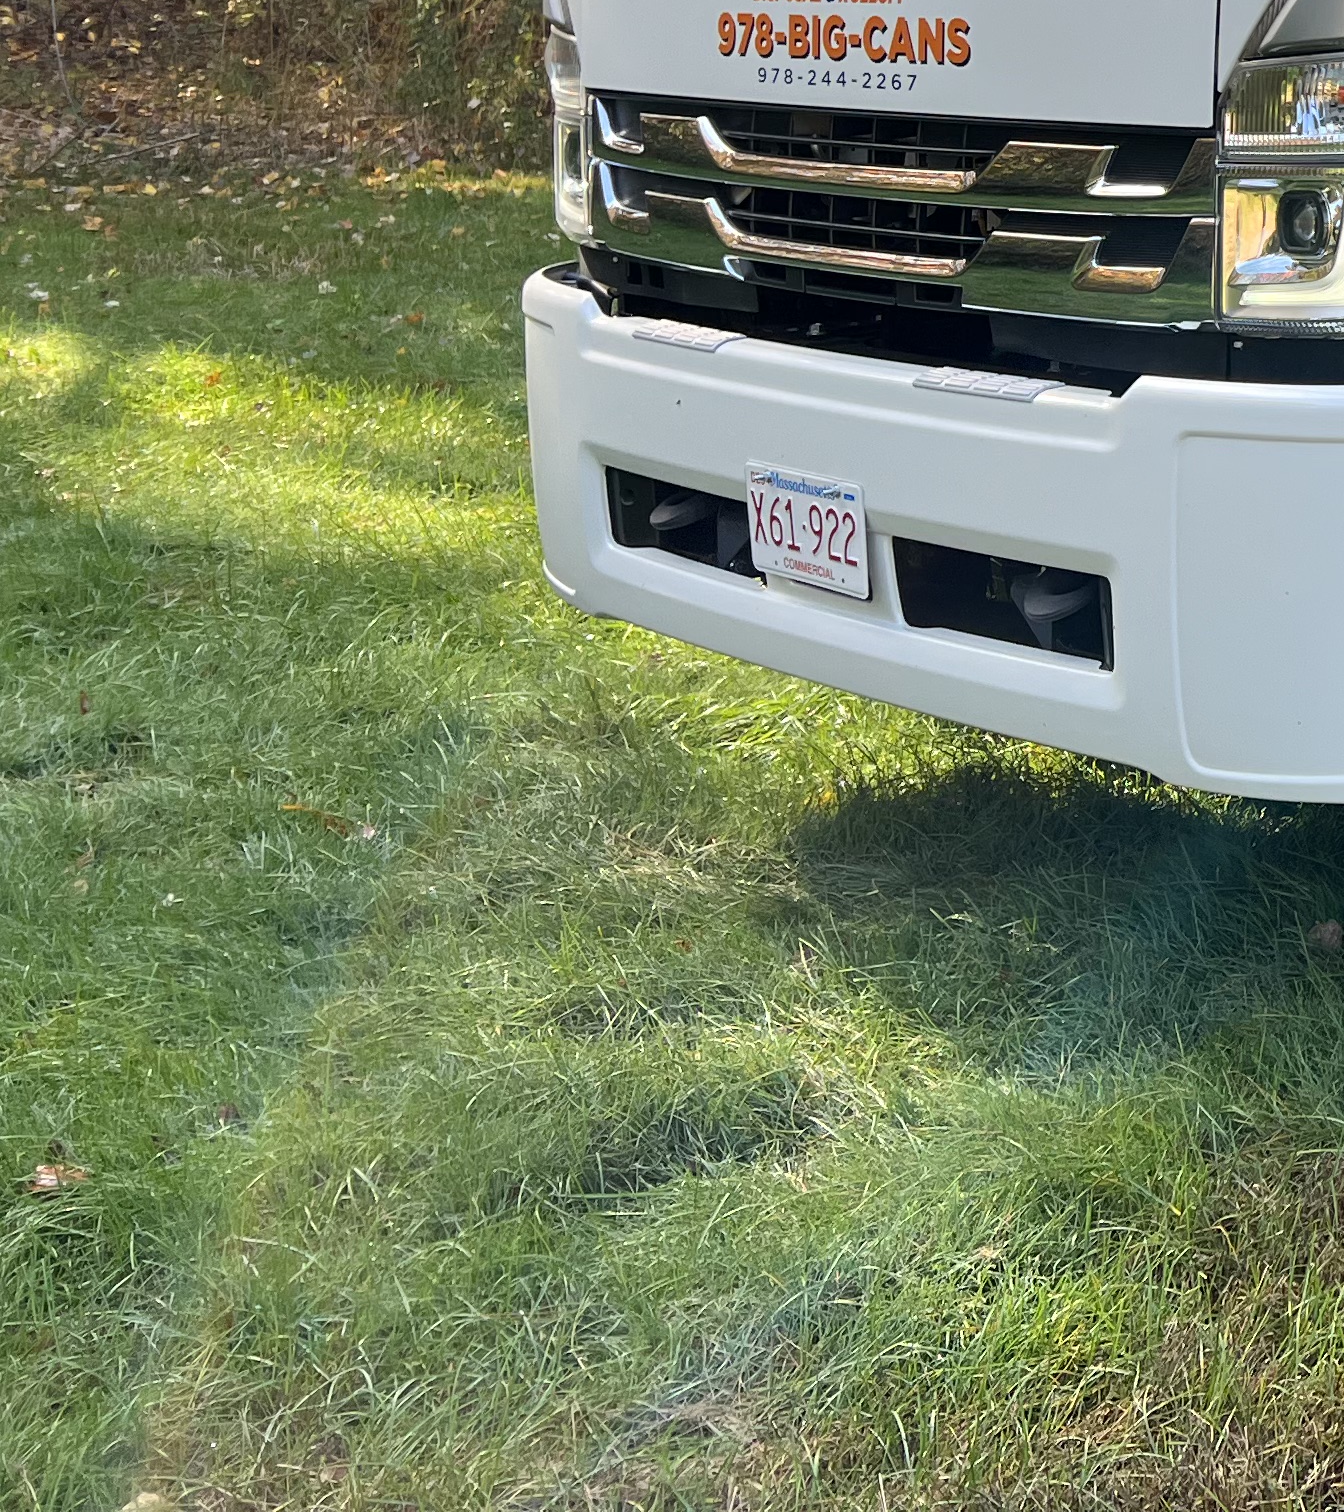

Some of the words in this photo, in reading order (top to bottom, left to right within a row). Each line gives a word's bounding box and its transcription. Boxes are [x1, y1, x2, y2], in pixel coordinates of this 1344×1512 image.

[717, 11, 971, 68] 978-BIG-CANS
[757, 67, 919, 92] 978-244-2267
[784, 557, 836, 581] COMMERCIAL
